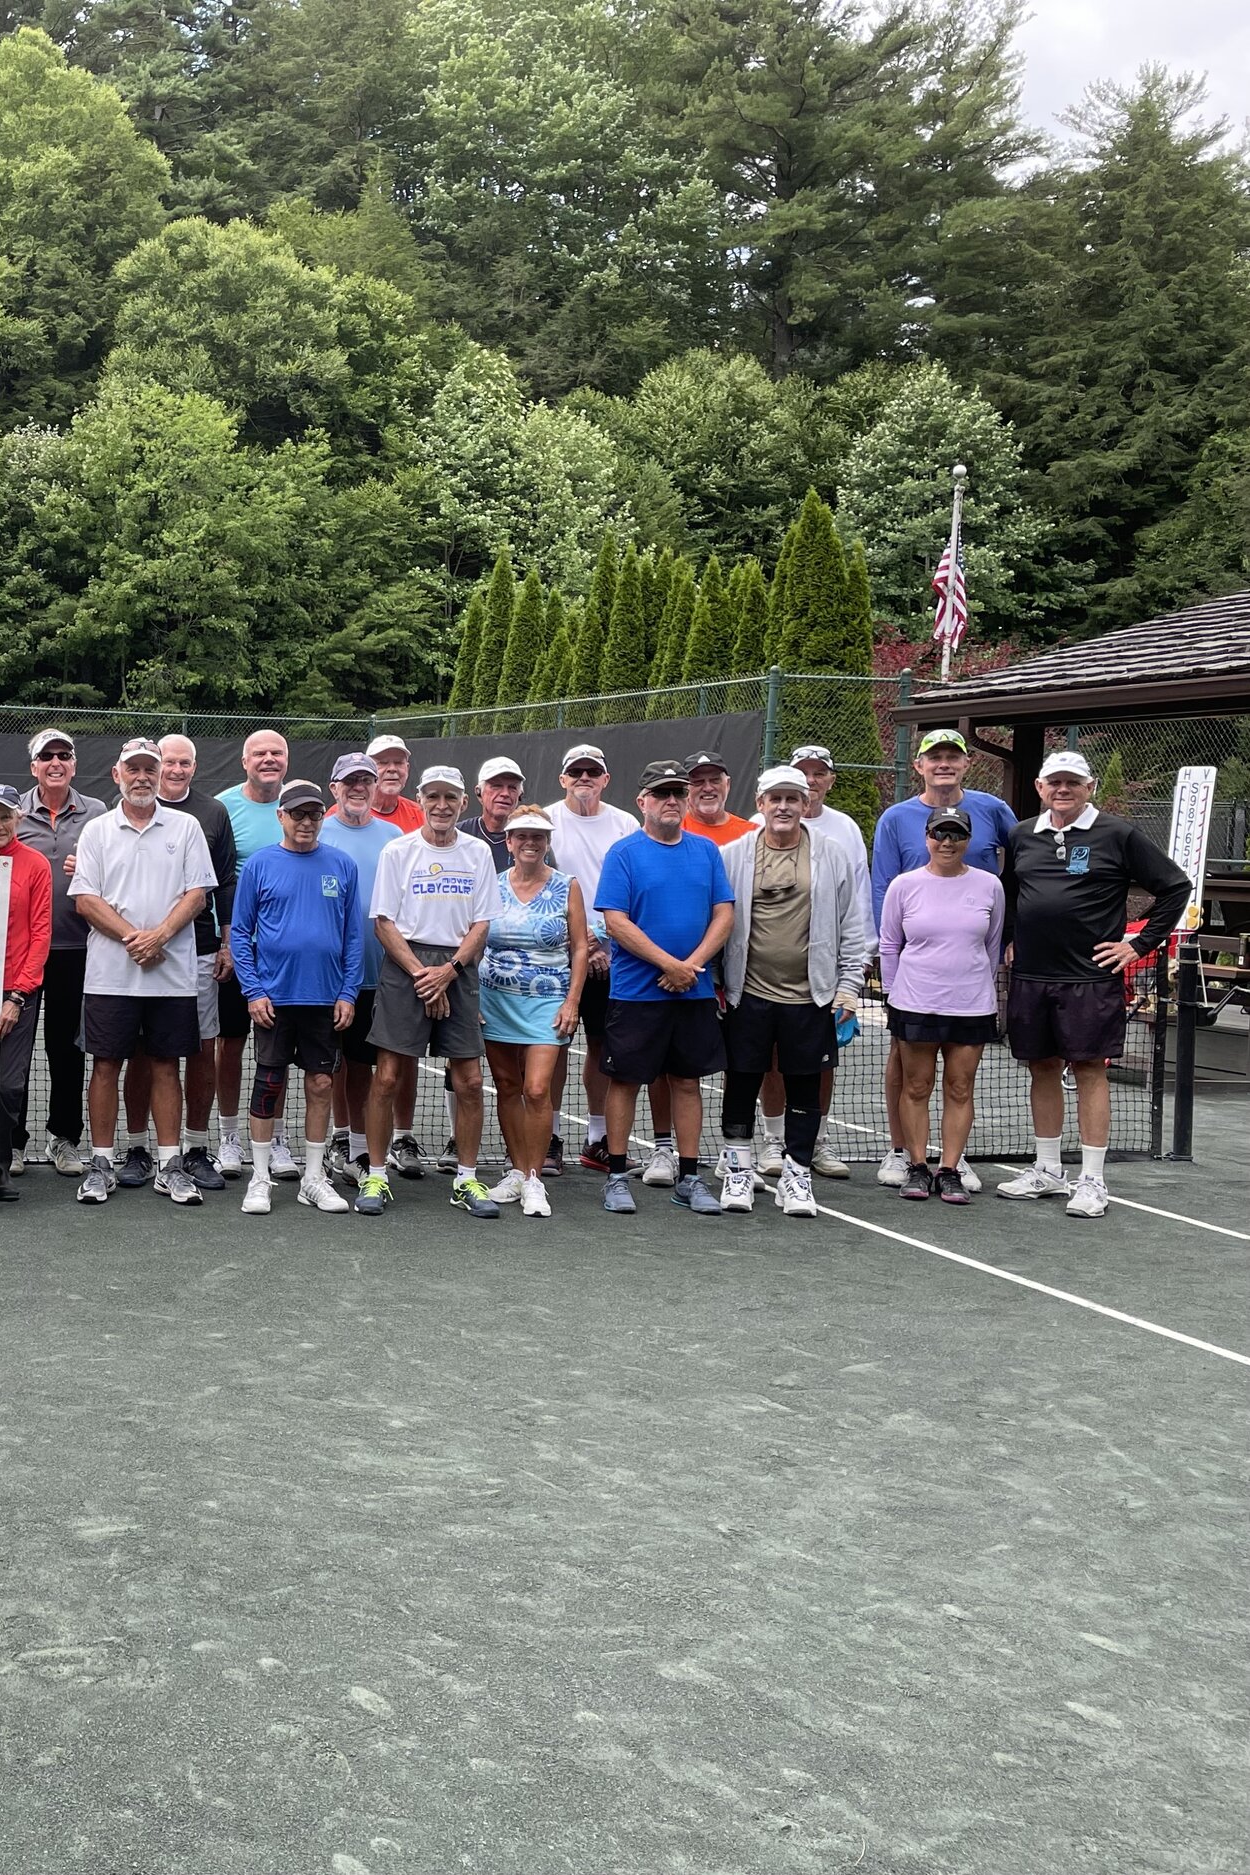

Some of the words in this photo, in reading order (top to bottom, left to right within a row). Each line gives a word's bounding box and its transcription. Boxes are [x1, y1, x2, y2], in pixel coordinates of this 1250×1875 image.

[1184, 769, 1191, 779] H
[1204, 769, 1210, 779] V
[1191, 782, 1198, 794] S
[1190, 795, 1196, 806] 9
[1188, 808, 1195, 819] 8
[1187, 820, 1193, 831] 7
[1185, 833, 1192, 844] 6
[1184, 846, 1190, 856] 5
